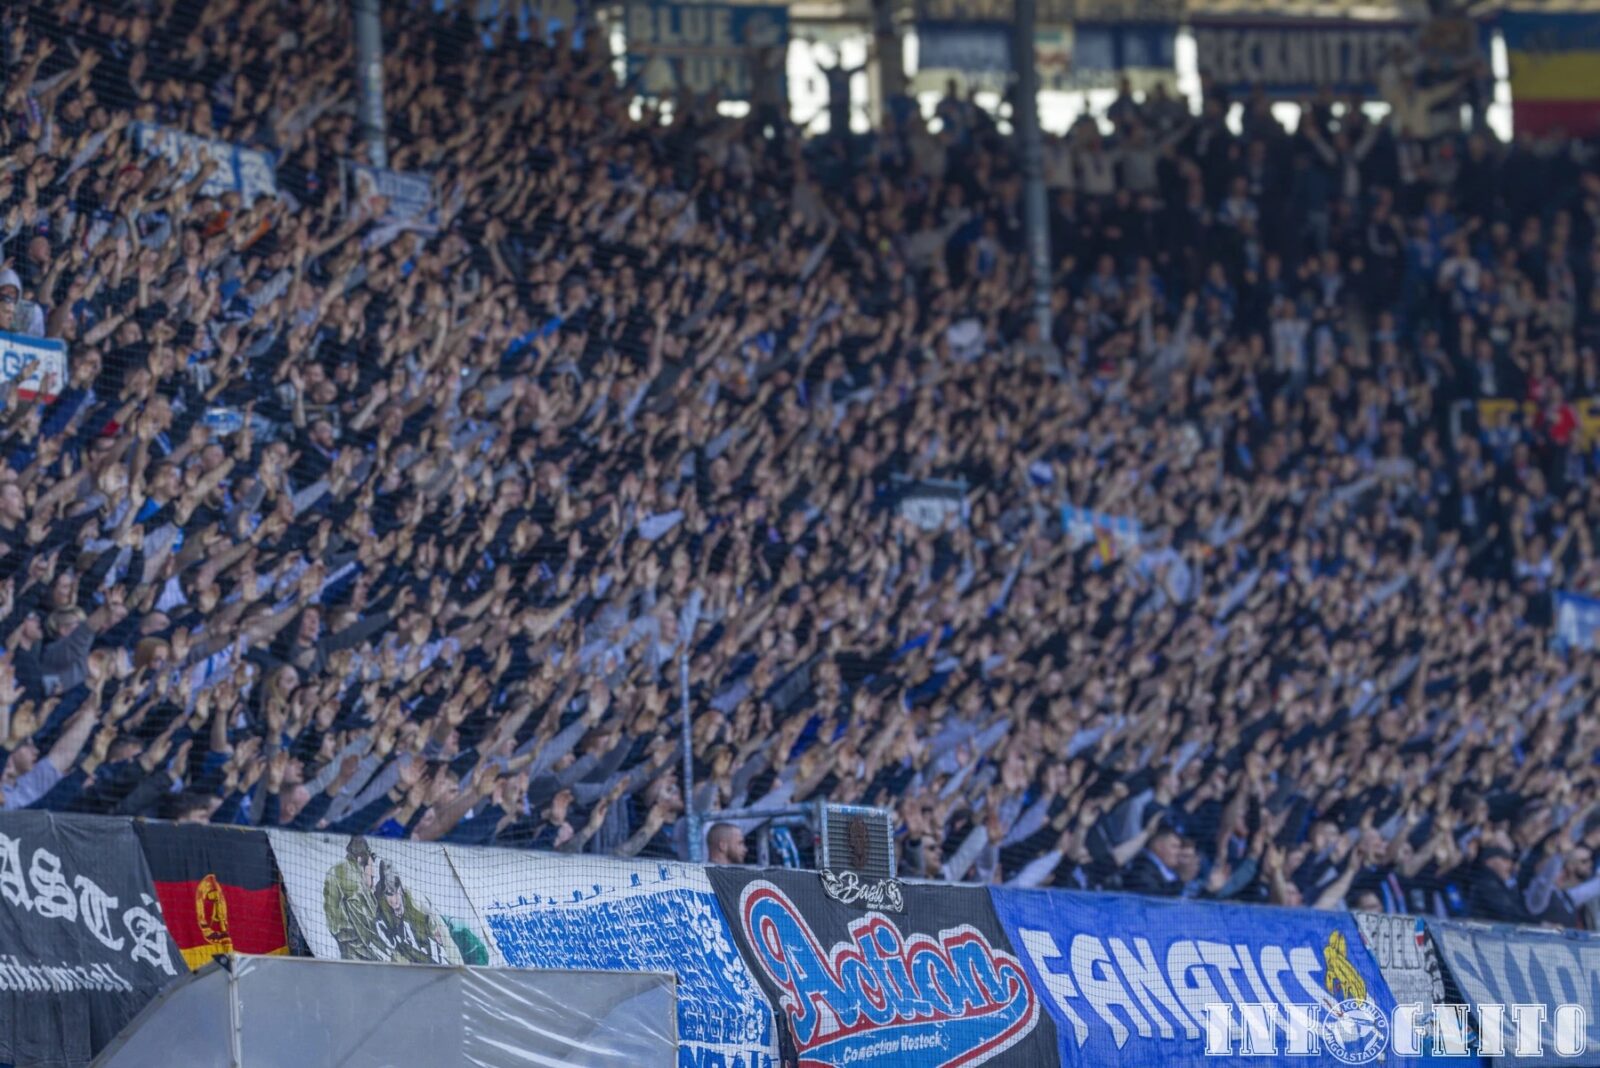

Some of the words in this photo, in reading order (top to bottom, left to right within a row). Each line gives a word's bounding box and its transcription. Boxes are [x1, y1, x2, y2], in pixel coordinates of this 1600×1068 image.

[741, 880, 1038, 1051] Action
[1018, 928, 1350, 1050] FANATICS
[901, 1030, 942, 1052] Rostock
